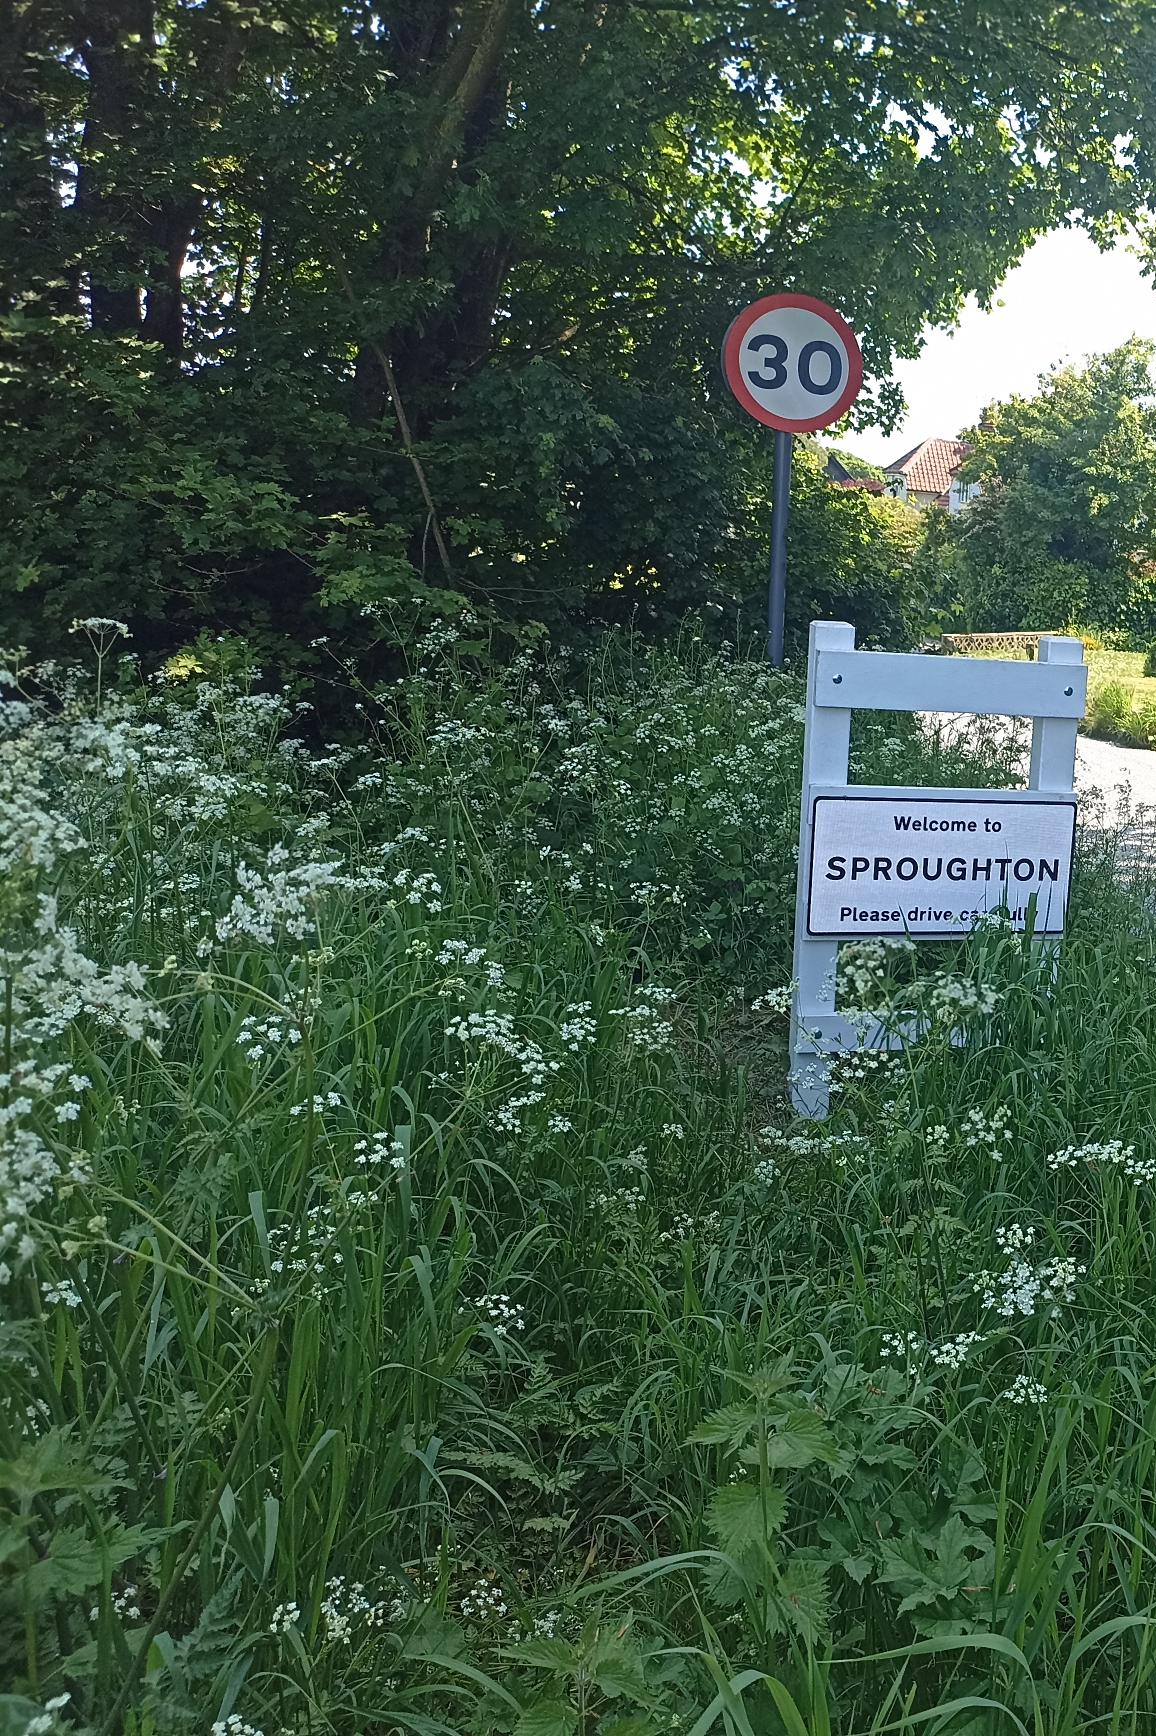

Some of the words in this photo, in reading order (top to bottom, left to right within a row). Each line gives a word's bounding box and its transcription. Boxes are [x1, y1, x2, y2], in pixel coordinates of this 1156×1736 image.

[747, 334, 843, 396] 30
[893, 815, 977, 833] Welcome
[984, 817, 1002, 833] to
[825, 856, 1060, 882] SPROUGHTON
[840, 906, 901, 922] Please
[907, 906, 953, 922] drive
